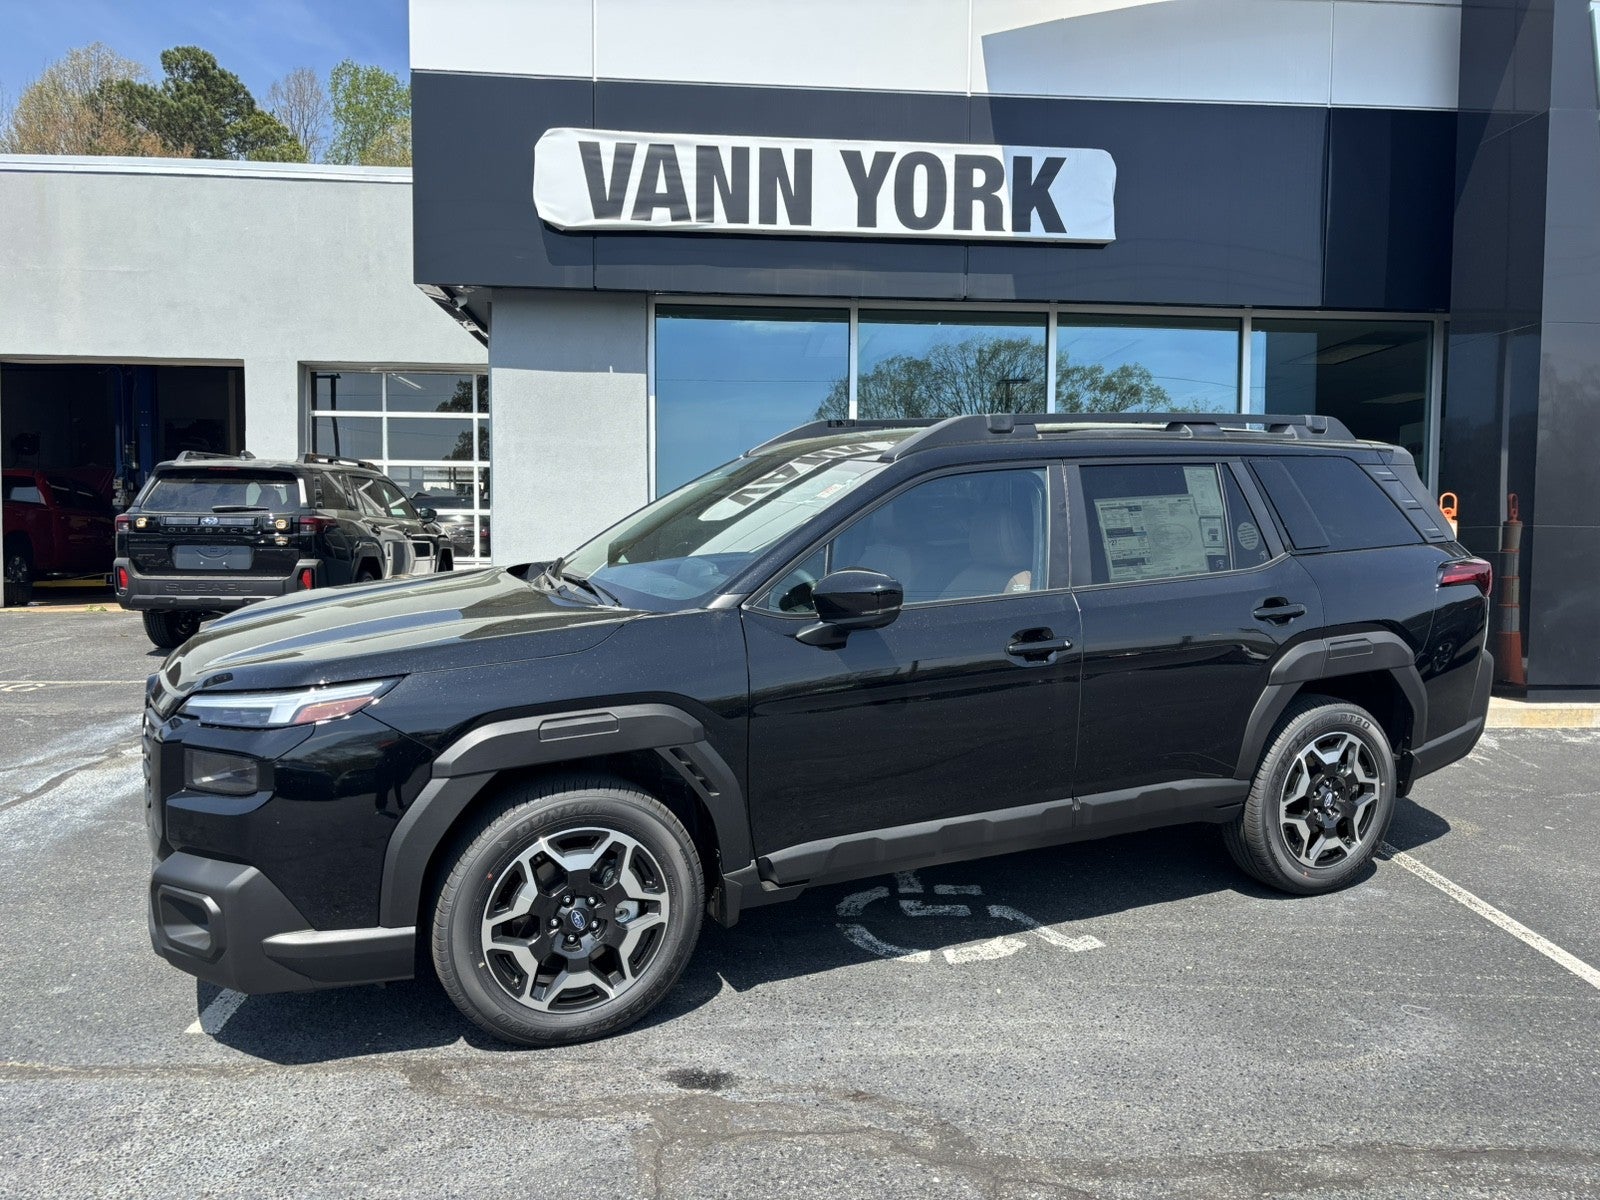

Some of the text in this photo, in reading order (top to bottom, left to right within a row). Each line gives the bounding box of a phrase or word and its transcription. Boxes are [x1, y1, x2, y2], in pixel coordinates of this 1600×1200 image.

[578, 141, 1067, 234] VANN YORK
[167, 526, 252, 535] OUTBACK
[516, 802, 611, 839] DUNLOP
